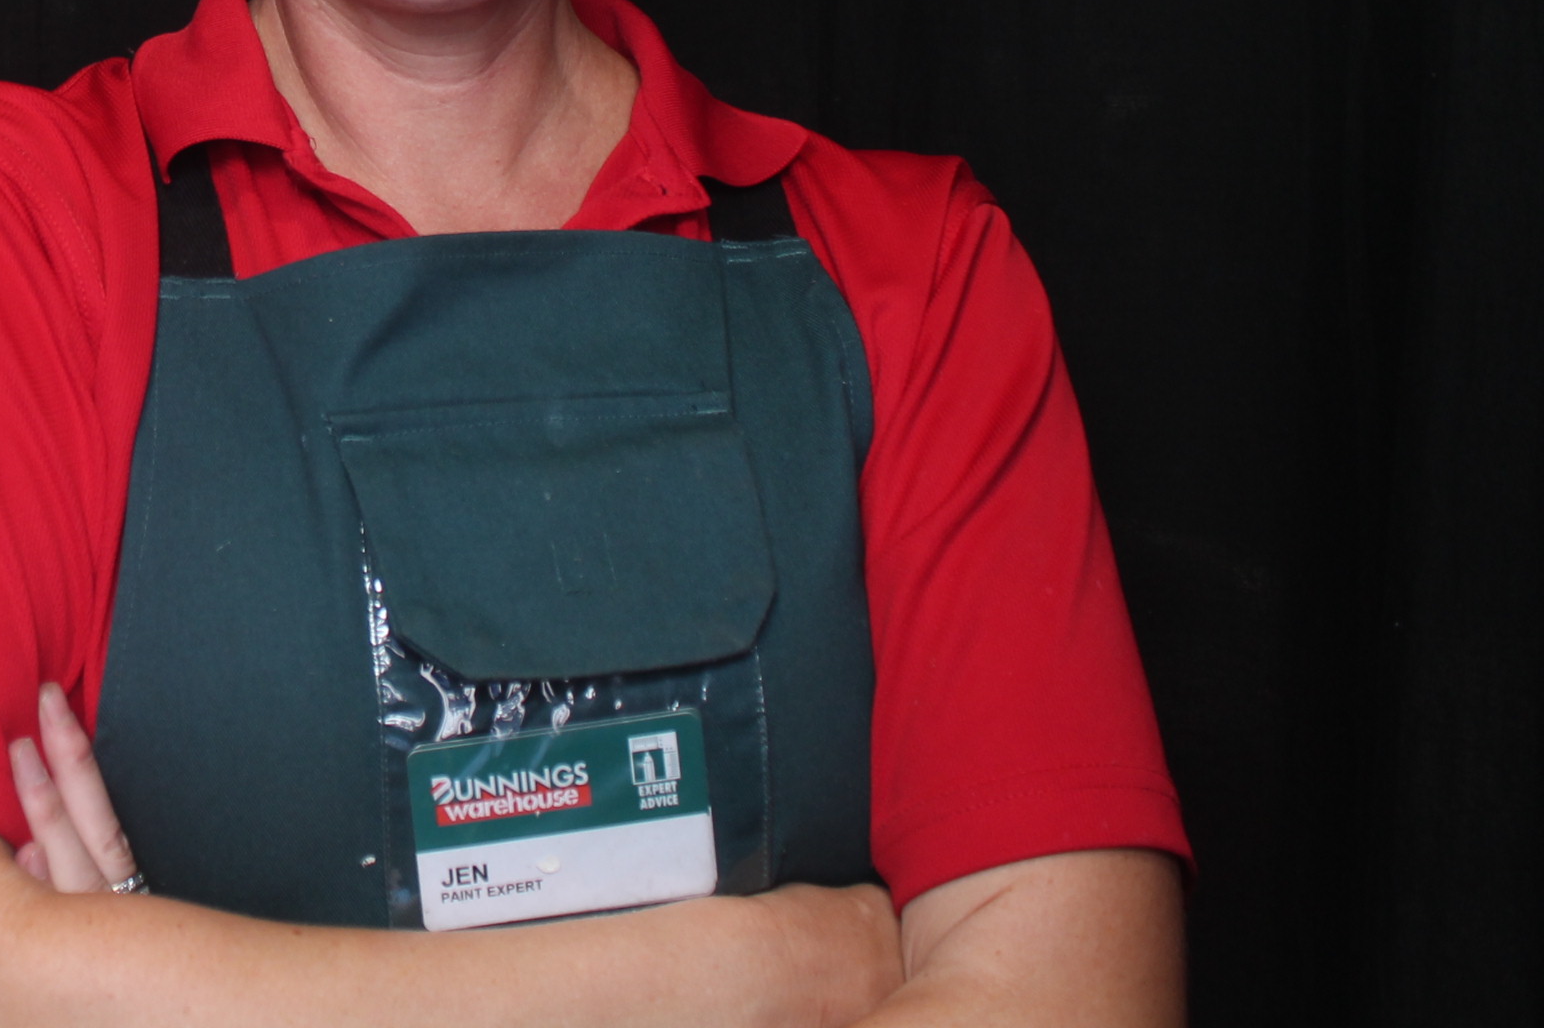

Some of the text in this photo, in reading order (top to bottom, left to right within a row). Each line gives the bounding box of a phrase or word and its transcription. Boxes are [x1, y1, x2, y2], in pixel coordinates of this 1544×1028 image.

[431, 761, 589, 805] BUNNINGS
[638, 781, 677, 796] EXPERT
[445, 789, 579, 822] warehouse
[639, 795, 678, 810] ADVICE
[441, 864, 488, 887] JEN
[441, 880, 543, 903] PAINT EXPERT
